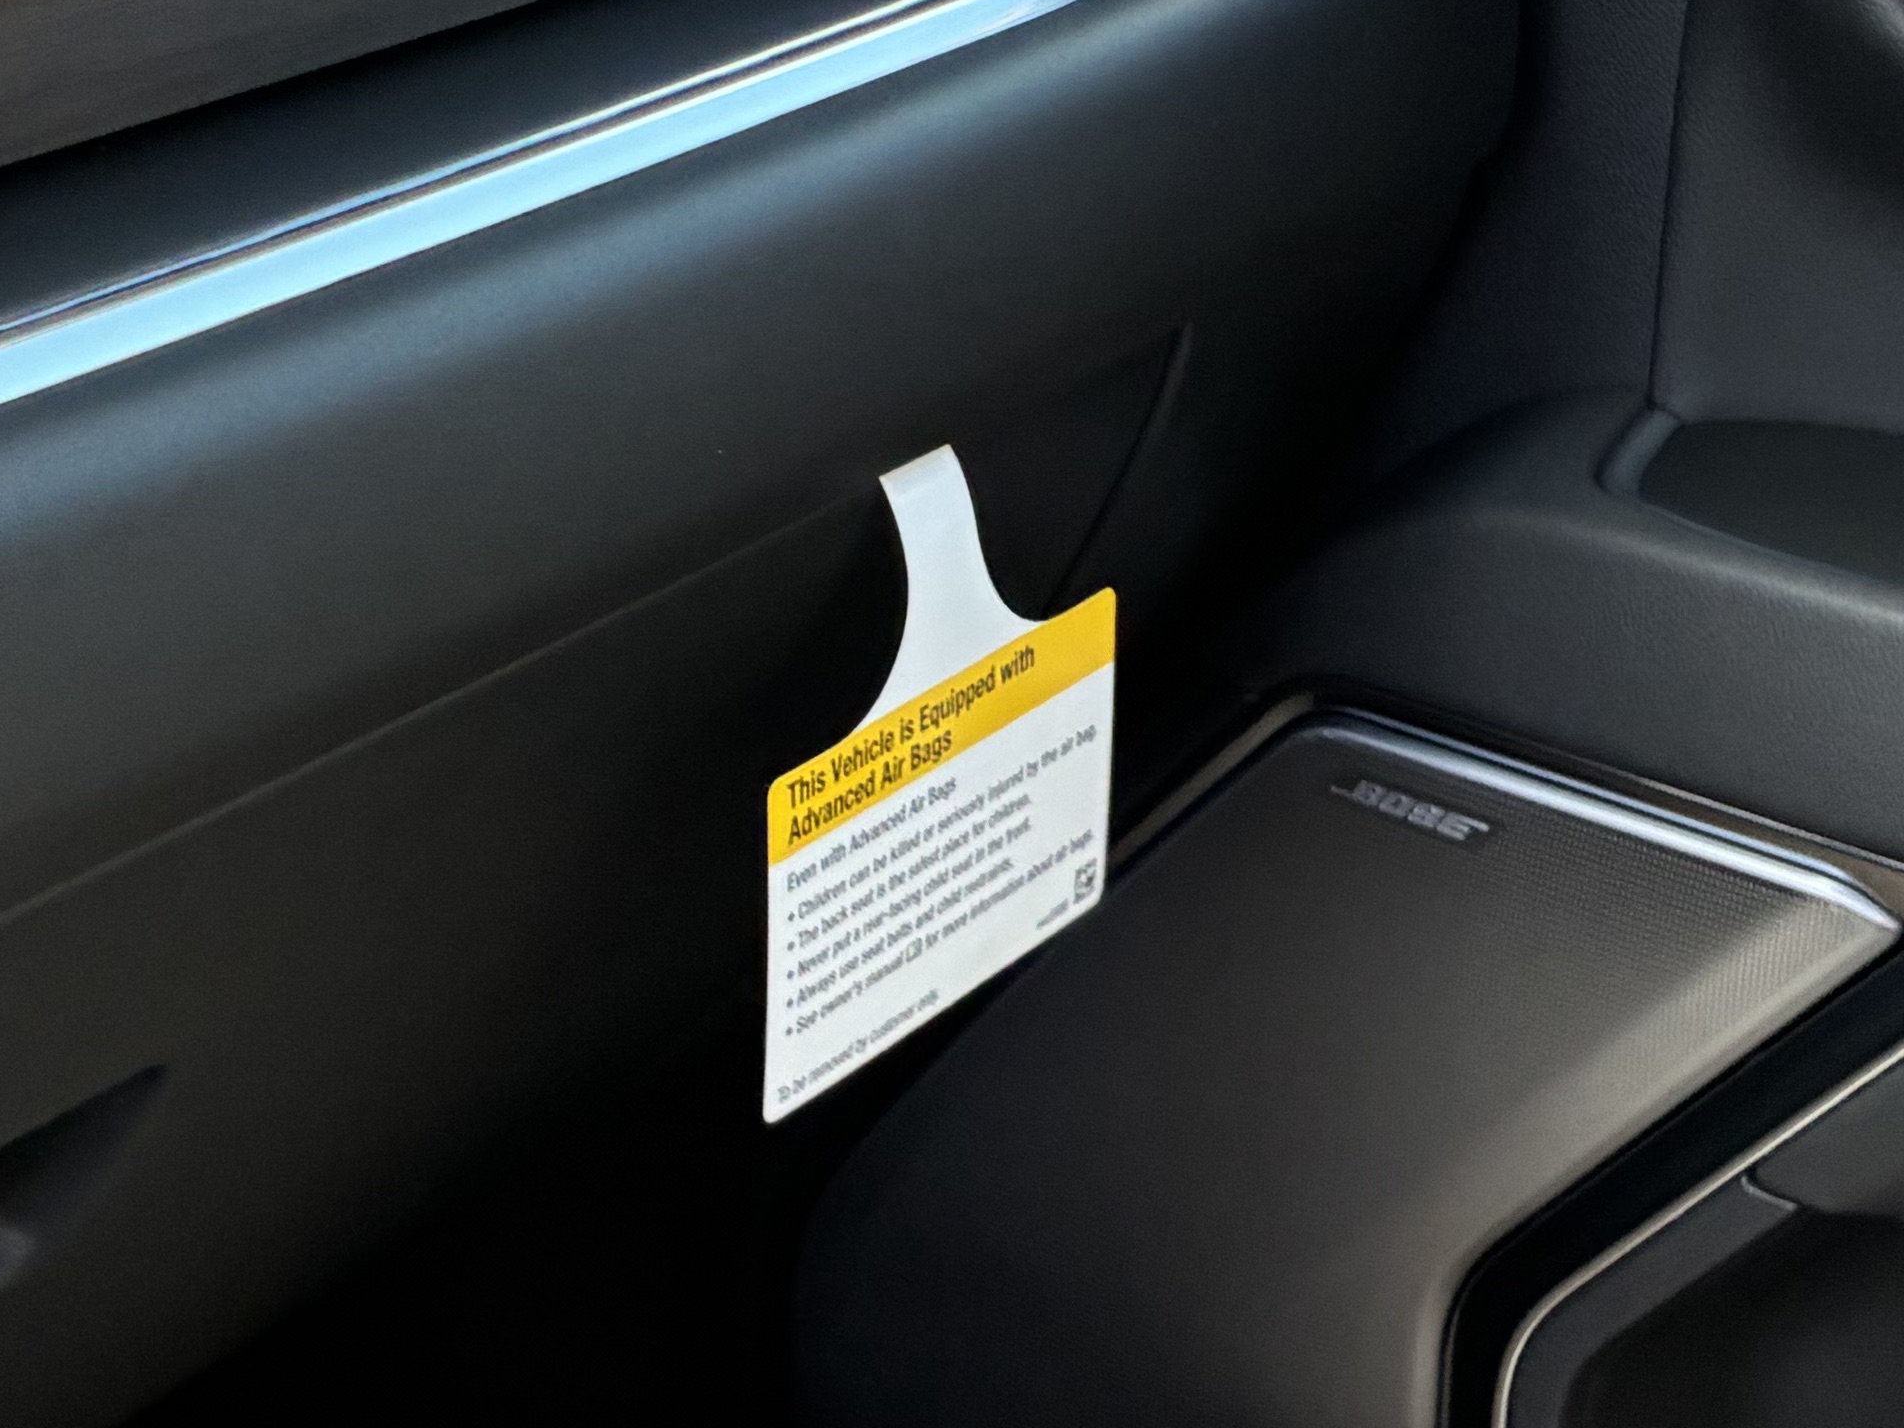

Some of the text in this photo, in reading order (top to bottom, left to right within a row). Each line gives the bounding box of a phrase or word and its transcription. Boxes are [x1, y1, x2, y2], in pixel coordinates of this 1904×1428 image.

[787, 646, 1035, 808] This Vehicle is Equipped with
[787, 778, 956, 892] Even with Advanced Air Bags
[789, 730, 952, 844] Advanced Air Bags
[1330, 779, 1490, 842] BOSE
